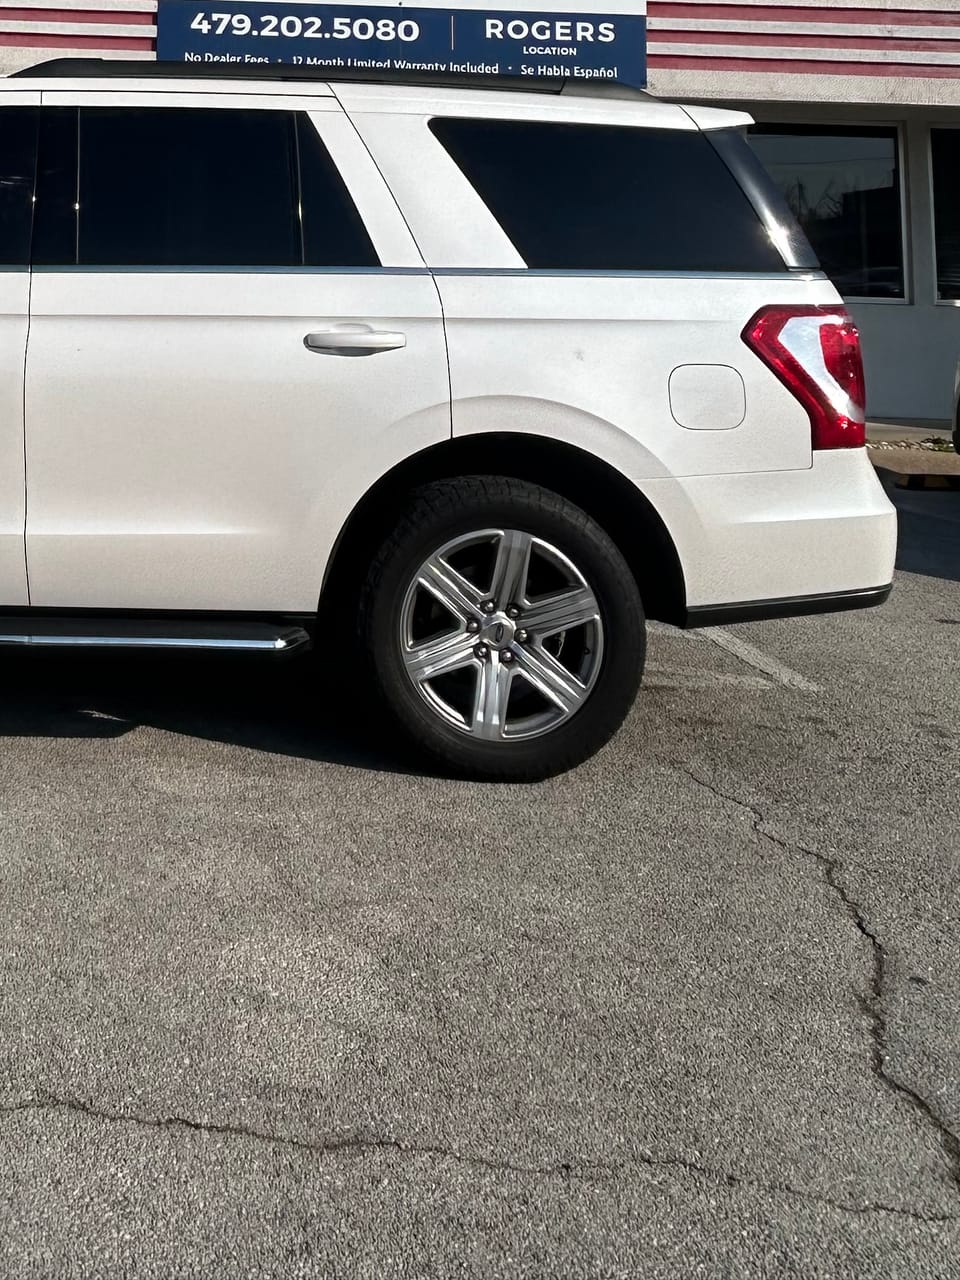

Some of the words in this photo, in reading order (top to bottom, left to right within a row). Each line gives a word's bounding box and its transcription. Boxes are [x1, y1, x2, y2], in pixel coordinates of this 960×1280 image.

[190, 12, 420, 42] 479.202.5080
[485, 19, 615, 43] ROGERS
[184, 52, 202, 62] No
[204, 52, 242, 63] Dealer
[244, 54, 270, 64] Fees
[523, 46, 577, 56] LOCATION
[292, 55, 303, 65] 12
[306, 56, 344, 67] Month
[347, 57, 391, 68] Limited
[394, 59, 446, 71] Warranty
[449, 61, 499, 74] Included
[521, 64, 534, 75] Se
[538, 65, 571, 77] Habla
[574, 66, 618, 79] Español
